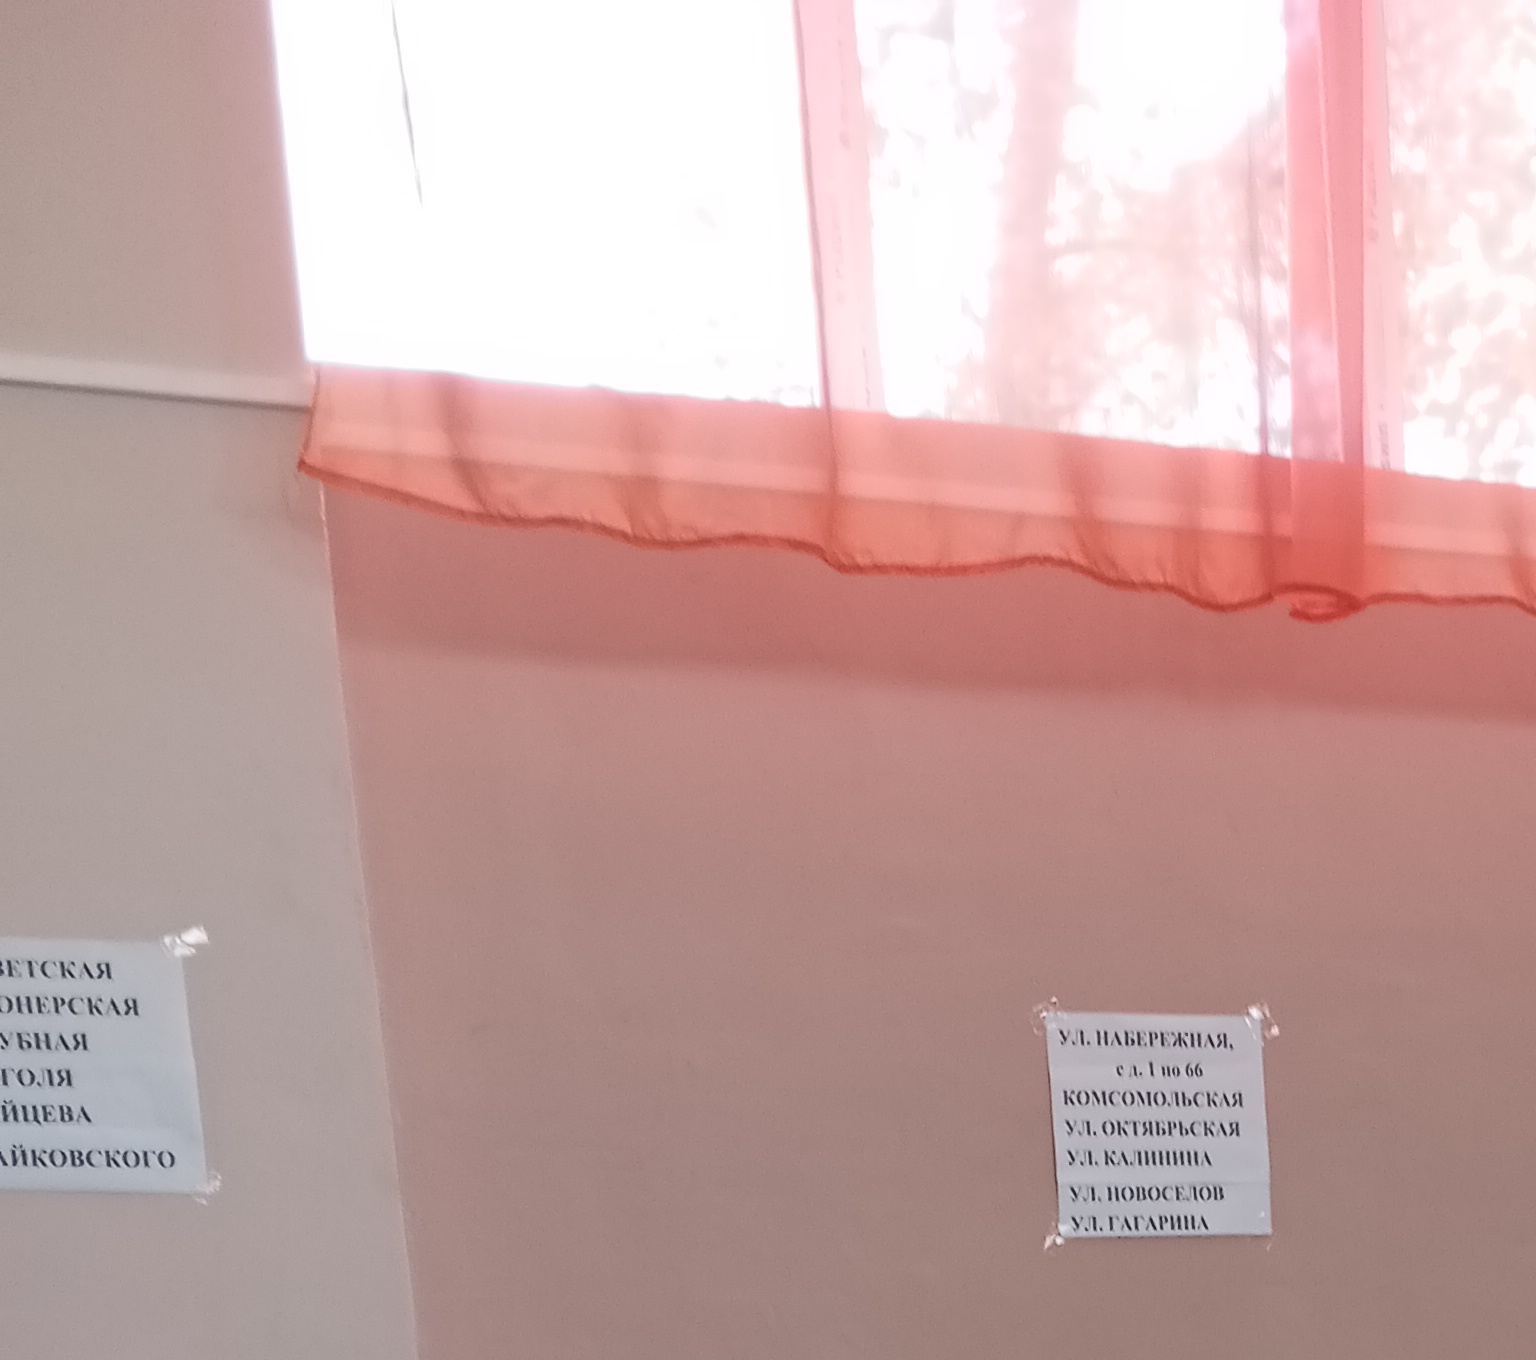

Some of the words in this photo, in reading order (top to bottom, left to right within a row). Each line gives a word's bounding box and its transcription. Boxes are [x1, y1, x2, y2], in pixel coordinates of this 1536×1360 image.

[0, 995, 140, 1016] ОНЕРСКАЯ
[1058, 1029, 1090, 1046] УЛ.
[1096, 1029, 1234, 1050] НАБЕРЕЖНАЯ,
[1, 1068, 73, 1087] ГОЛЯ
[1149, 1061, 1155, 1077] 1
[1185, 1062, 1203, 1078] 66
[1063, 1090, 1244, 1108] КОМСОМОЛЬСКАЯ
[1, 1100, 92, 1126] ЙЦЕВА
[1065, 1120, 1097, 1137] УЛ.
[1102, 1120, 1241, 1137] ОКТЯБРЬСКАЯ
[1067, 1150, 1098, 1166] УЛ.
[1104, 1150, 1213, 1167] КАЛИНИНА
[1069, 1186, 1101, 1202] УЛ.
[1107, 1185, 1225, 1202] НОВОСЕЛОВ
[1071, 1215, 1103, 1232] УЛ.
[1108, 1215, 1210, 1231] ГАГАРИНА
